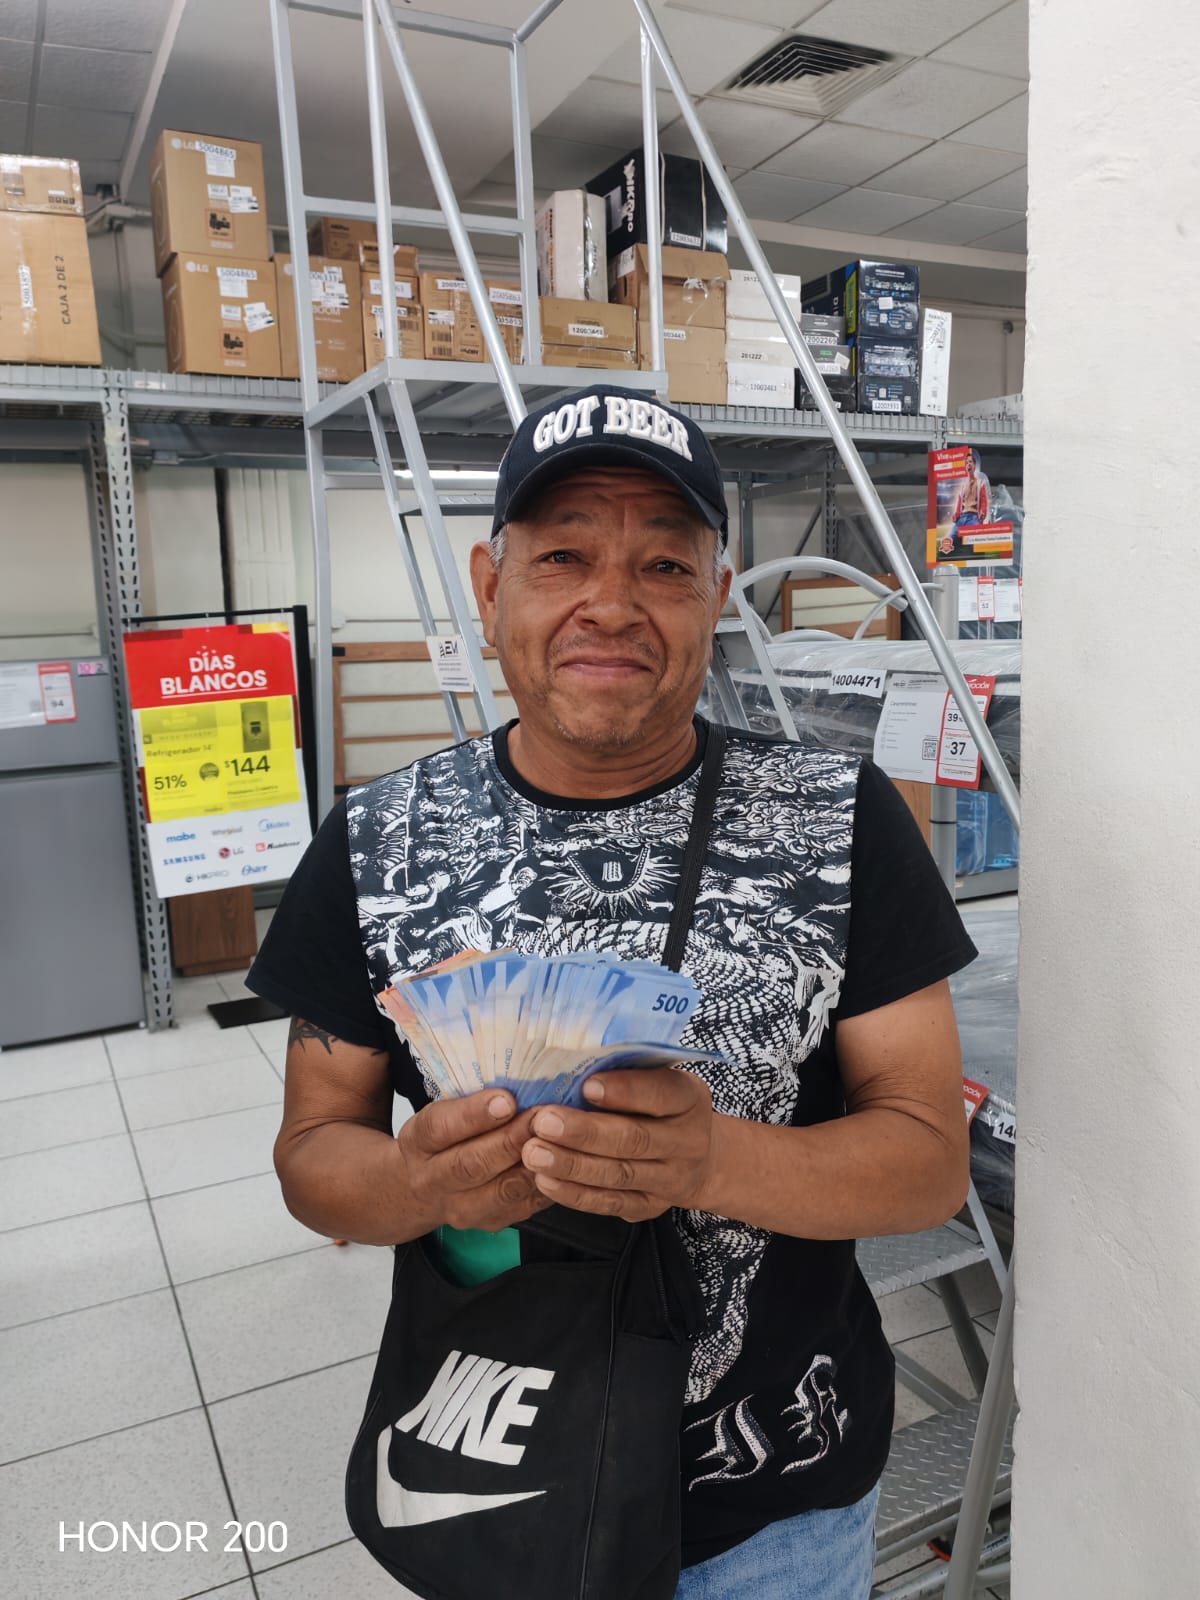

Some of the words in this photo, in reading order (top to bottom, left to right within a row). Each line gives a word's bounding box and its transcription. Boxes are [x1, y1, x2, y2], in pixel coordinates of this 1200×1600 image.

[56, 266, 67, 280] DE
[58, 283, 68, 292] 2
[59, 295, 71, 325] CAJA
[533, 395, 600, 453] GOT
[603, 396, 693, 462] BEER
[189, 652, 236, 673] DÍAS
[160, 669, 268, 696] BLANCOS
[832, 674, 882, 690] 14004471
[146, 747, 201, 757] Refrigerador
[950, 741, 966, 756] 37
[154, 774, 188, 790] 51%
[166, 832, 196, 843] mabe
[163, 853, 206, 865] SAMSUNG
[232, 848, 244, 856] LG
[652, 993, 690, 1015] 500
[998, 1122, 1016, 1139] 14
[395, 1350, 555, 1466] NIKE
